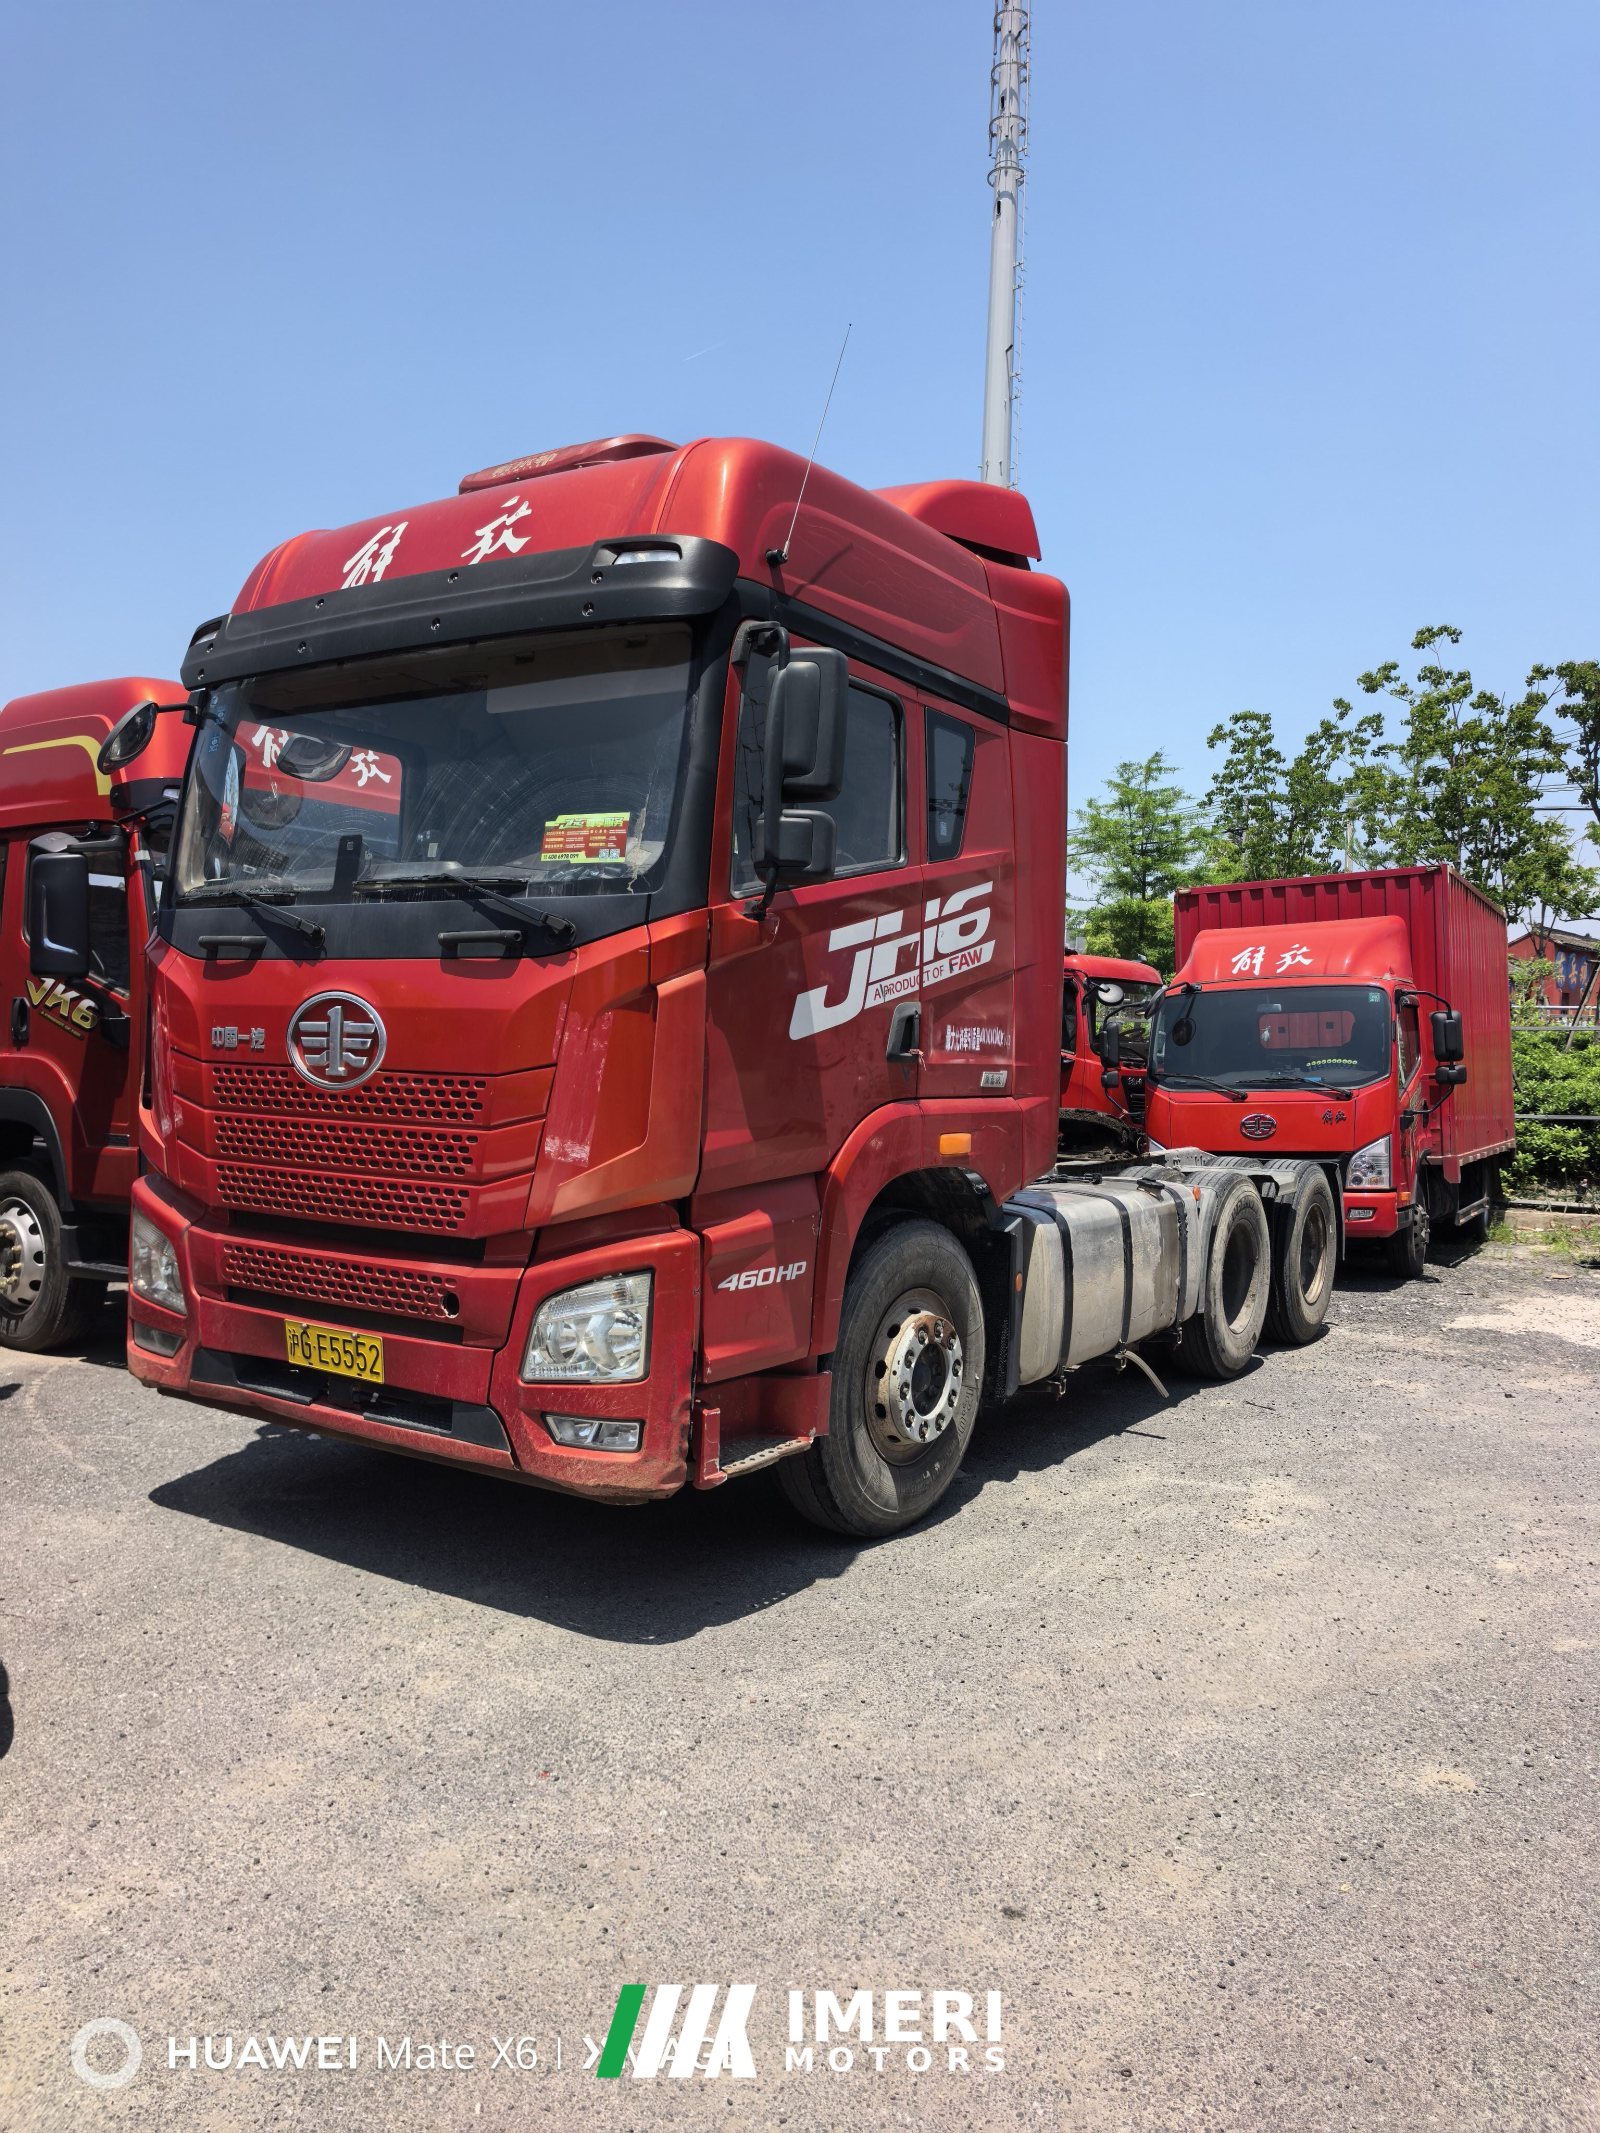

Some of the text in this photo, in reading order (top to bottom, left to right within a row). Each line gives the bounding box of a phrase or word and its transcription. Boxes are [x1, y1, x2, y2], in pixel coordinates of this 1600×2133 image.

[341, 496, 532, 590] 解放
[789, 881, 993, 1040] JH6
[874, 947, 983, 1000] A PRODUCT OF FAW
[1231, 943, 1314, 976] 解放
[211, 1026, 265, 1049] 中国一汽
